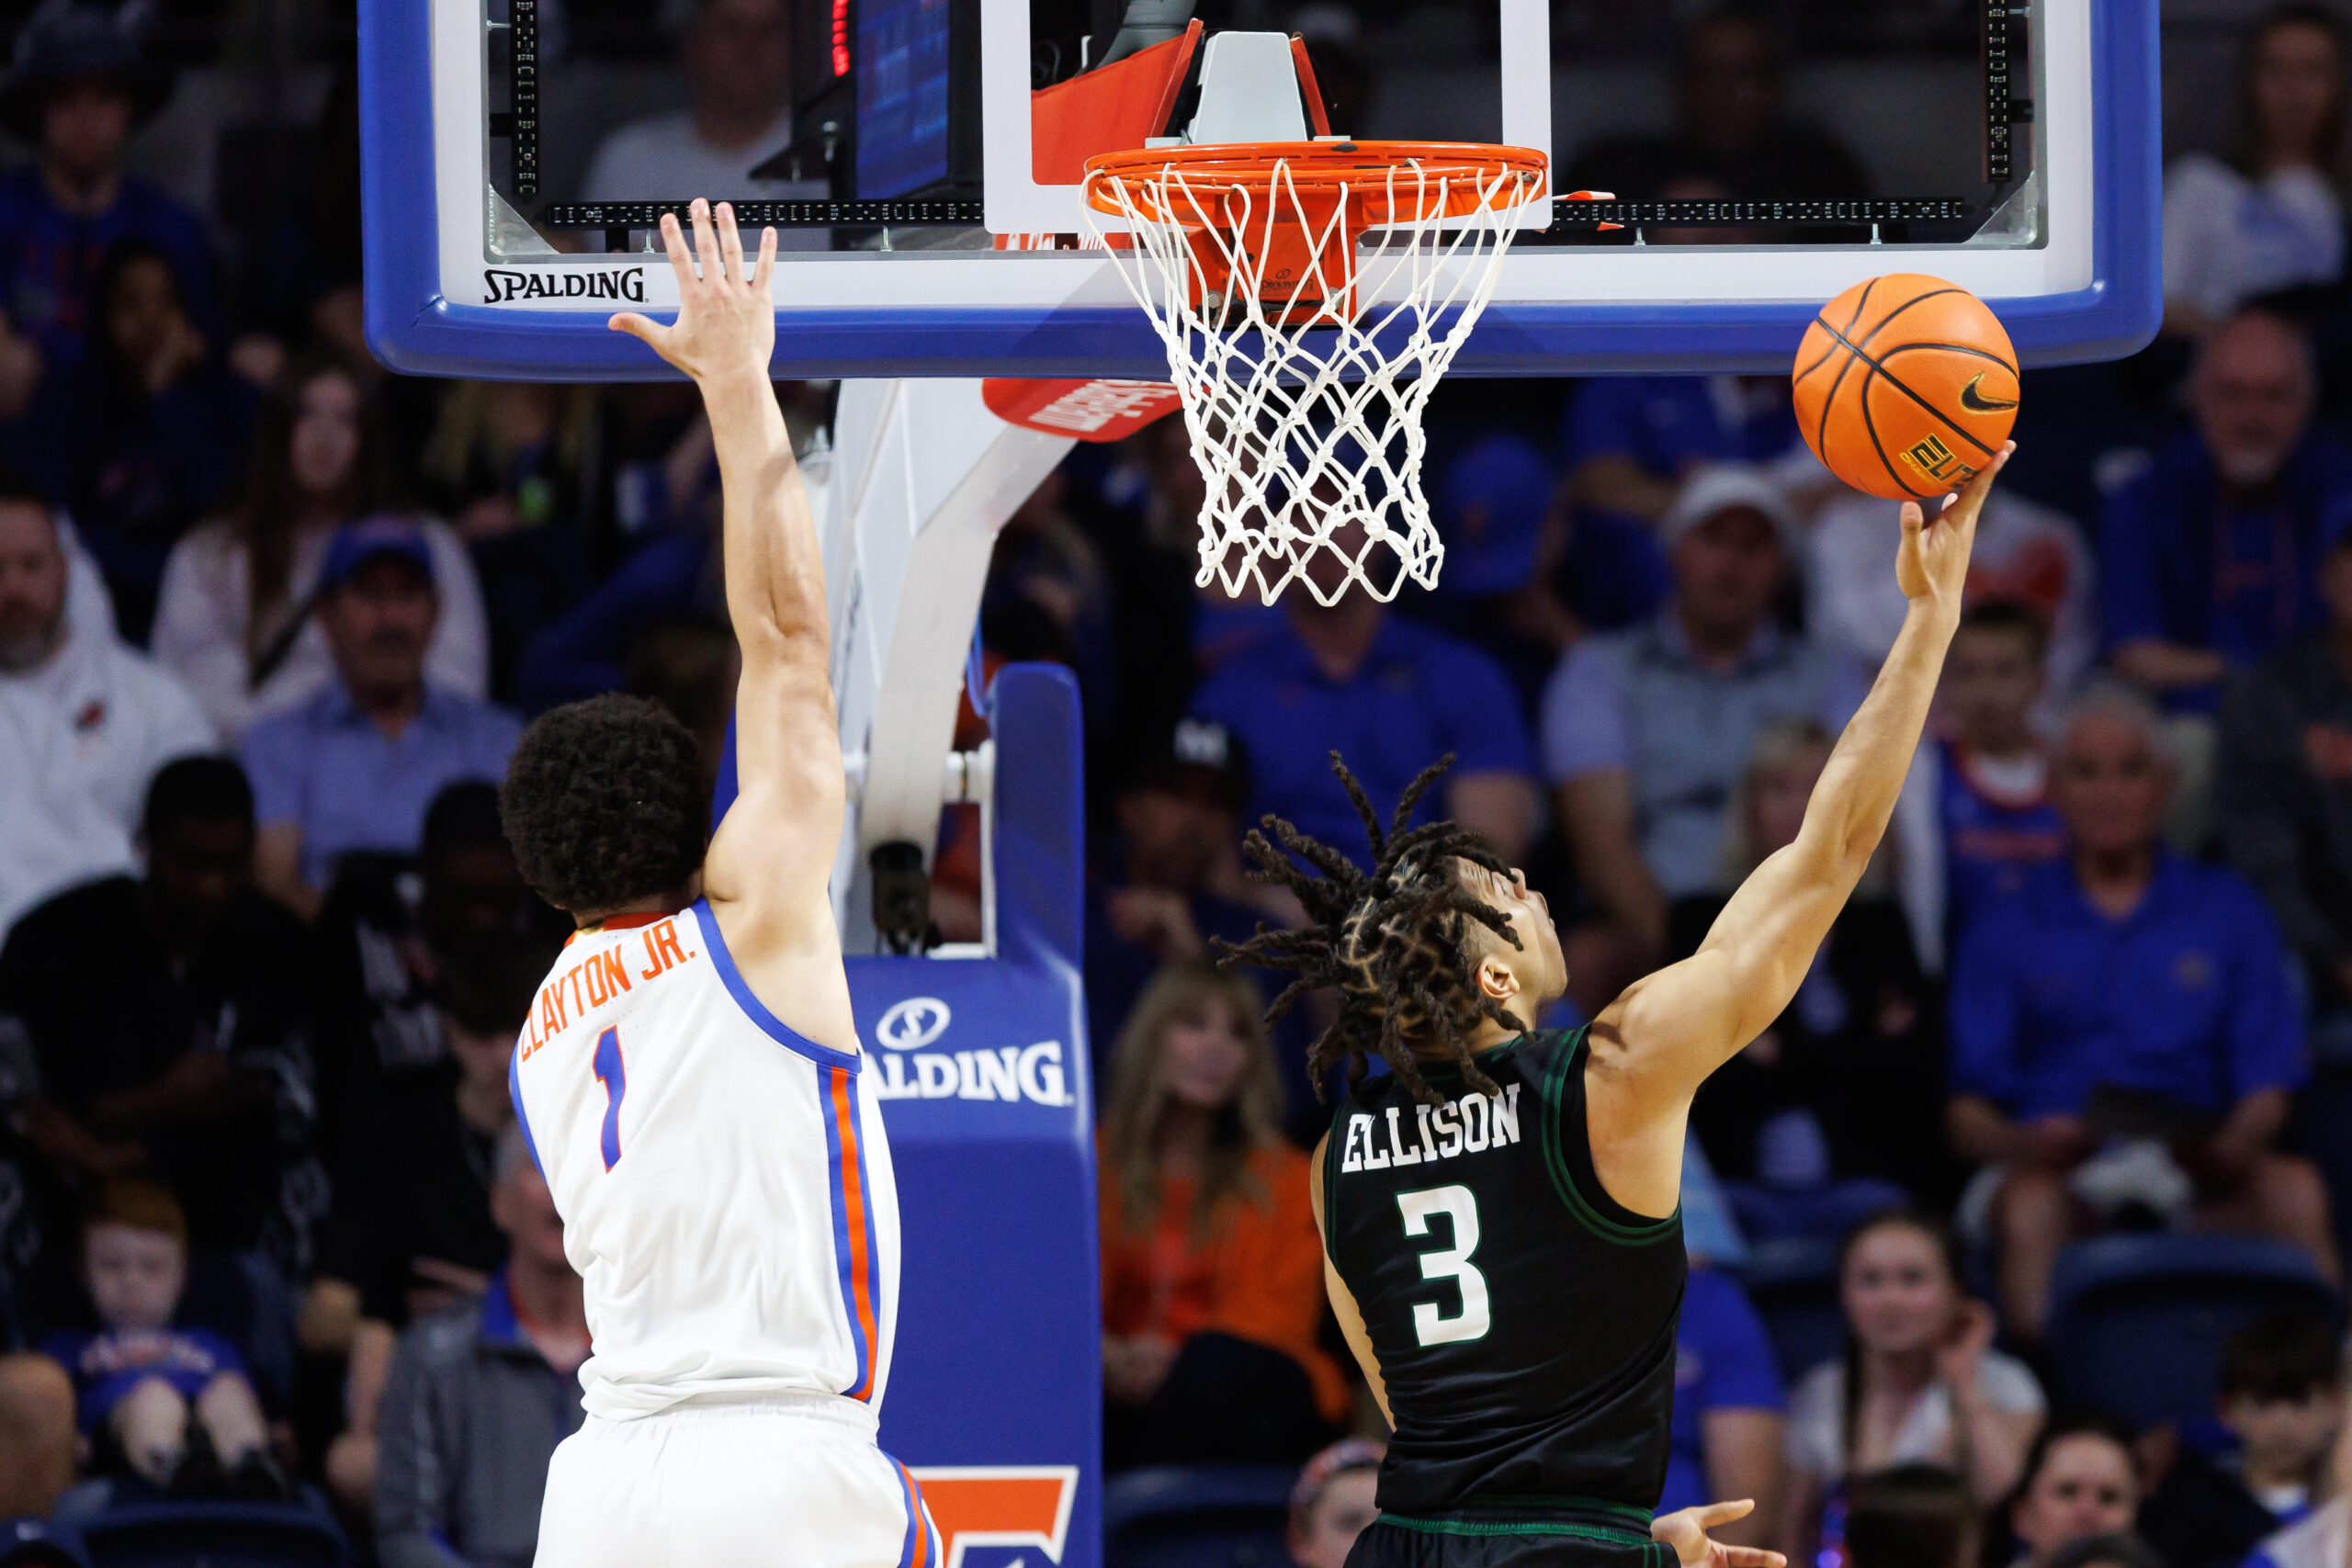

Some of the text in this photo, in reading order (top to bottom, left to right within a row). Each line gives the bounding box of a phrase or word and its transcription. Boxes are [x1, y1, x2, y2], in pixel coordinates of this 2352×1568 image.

[484, 267, 643, 304] SPALDING
[521, 919, 695, 1063] CLAYTON JR.
[592, 1024, 626, 1174] 1
[1341, 1082, 1521, 1173] ELLISON
[1395, 1181, 1491, 1348] 3
